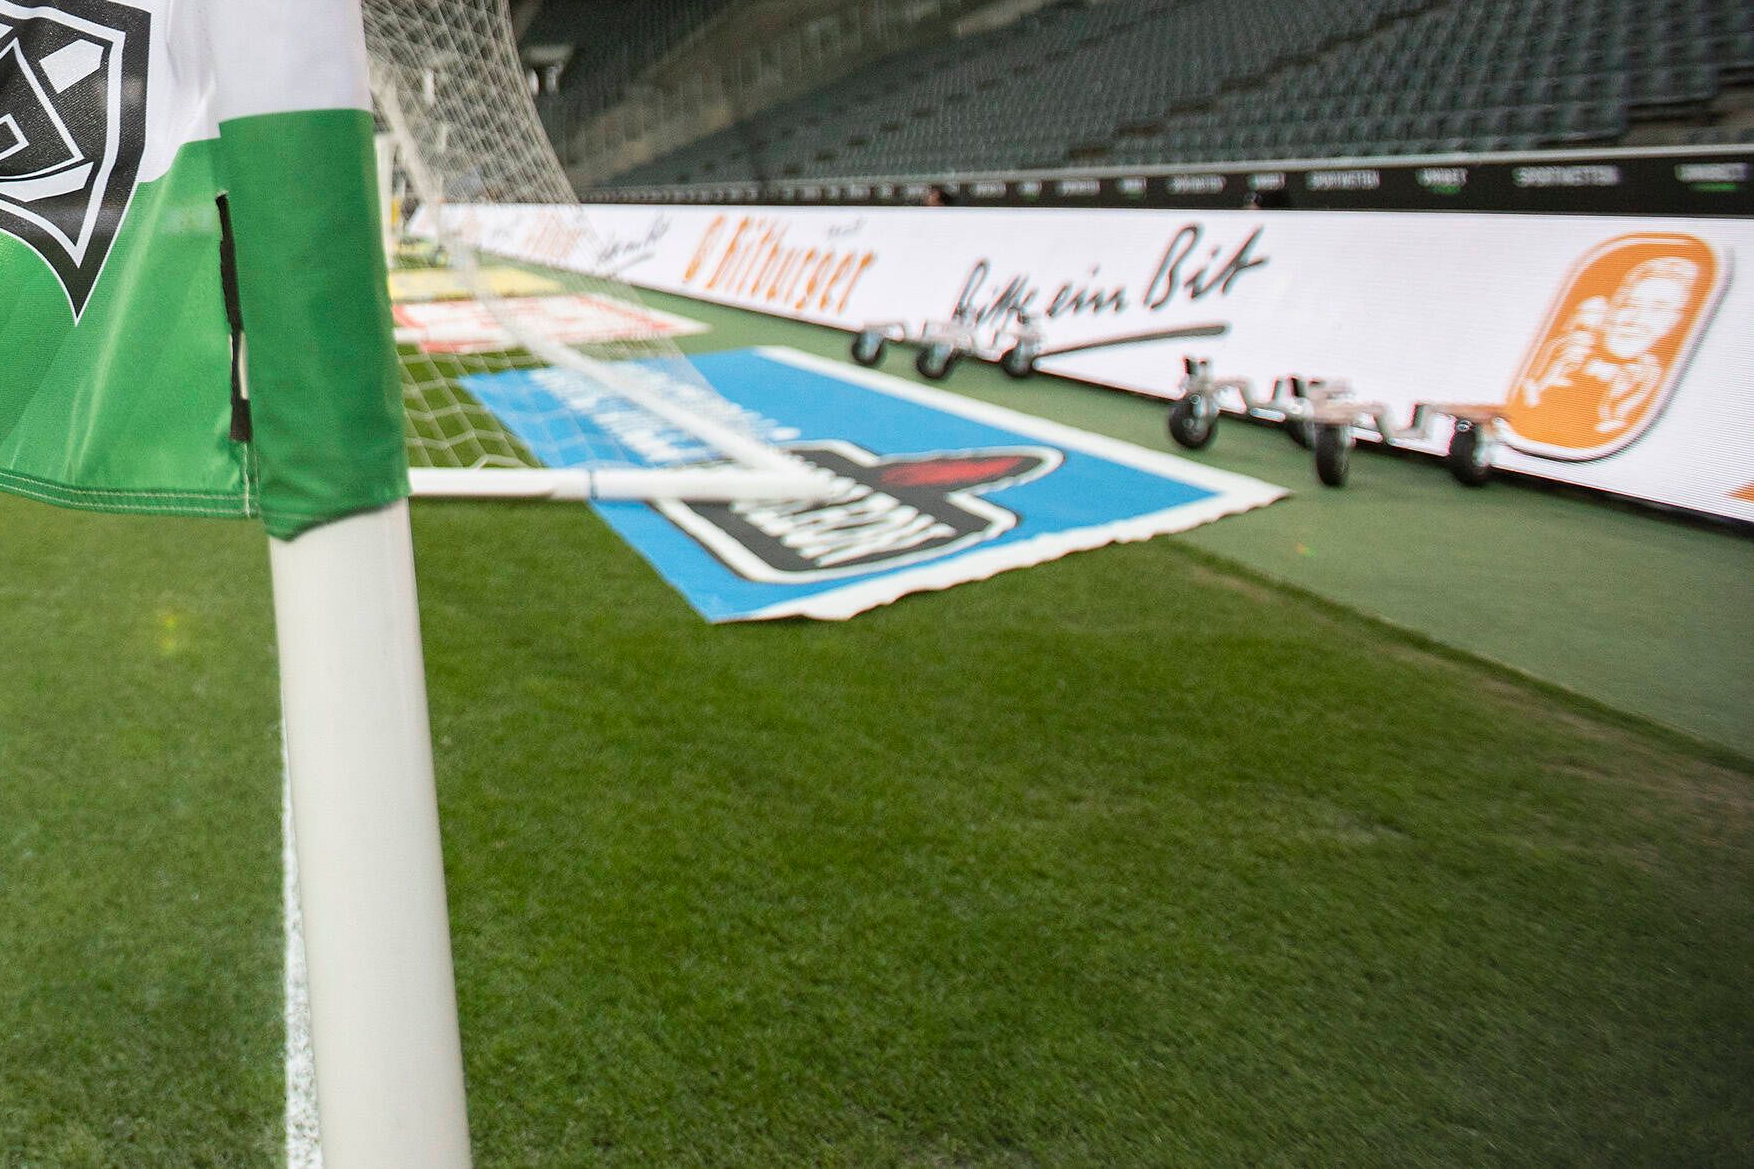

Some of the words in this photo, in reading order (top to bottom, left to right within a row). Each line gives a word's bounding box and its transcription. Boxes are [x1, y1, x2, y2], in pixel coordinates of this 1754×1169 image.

[705, 215, 878, 314] Bitburger
[1045, 264, 1130, 318] ein
[1143, 221, 1269, 310] Bit
